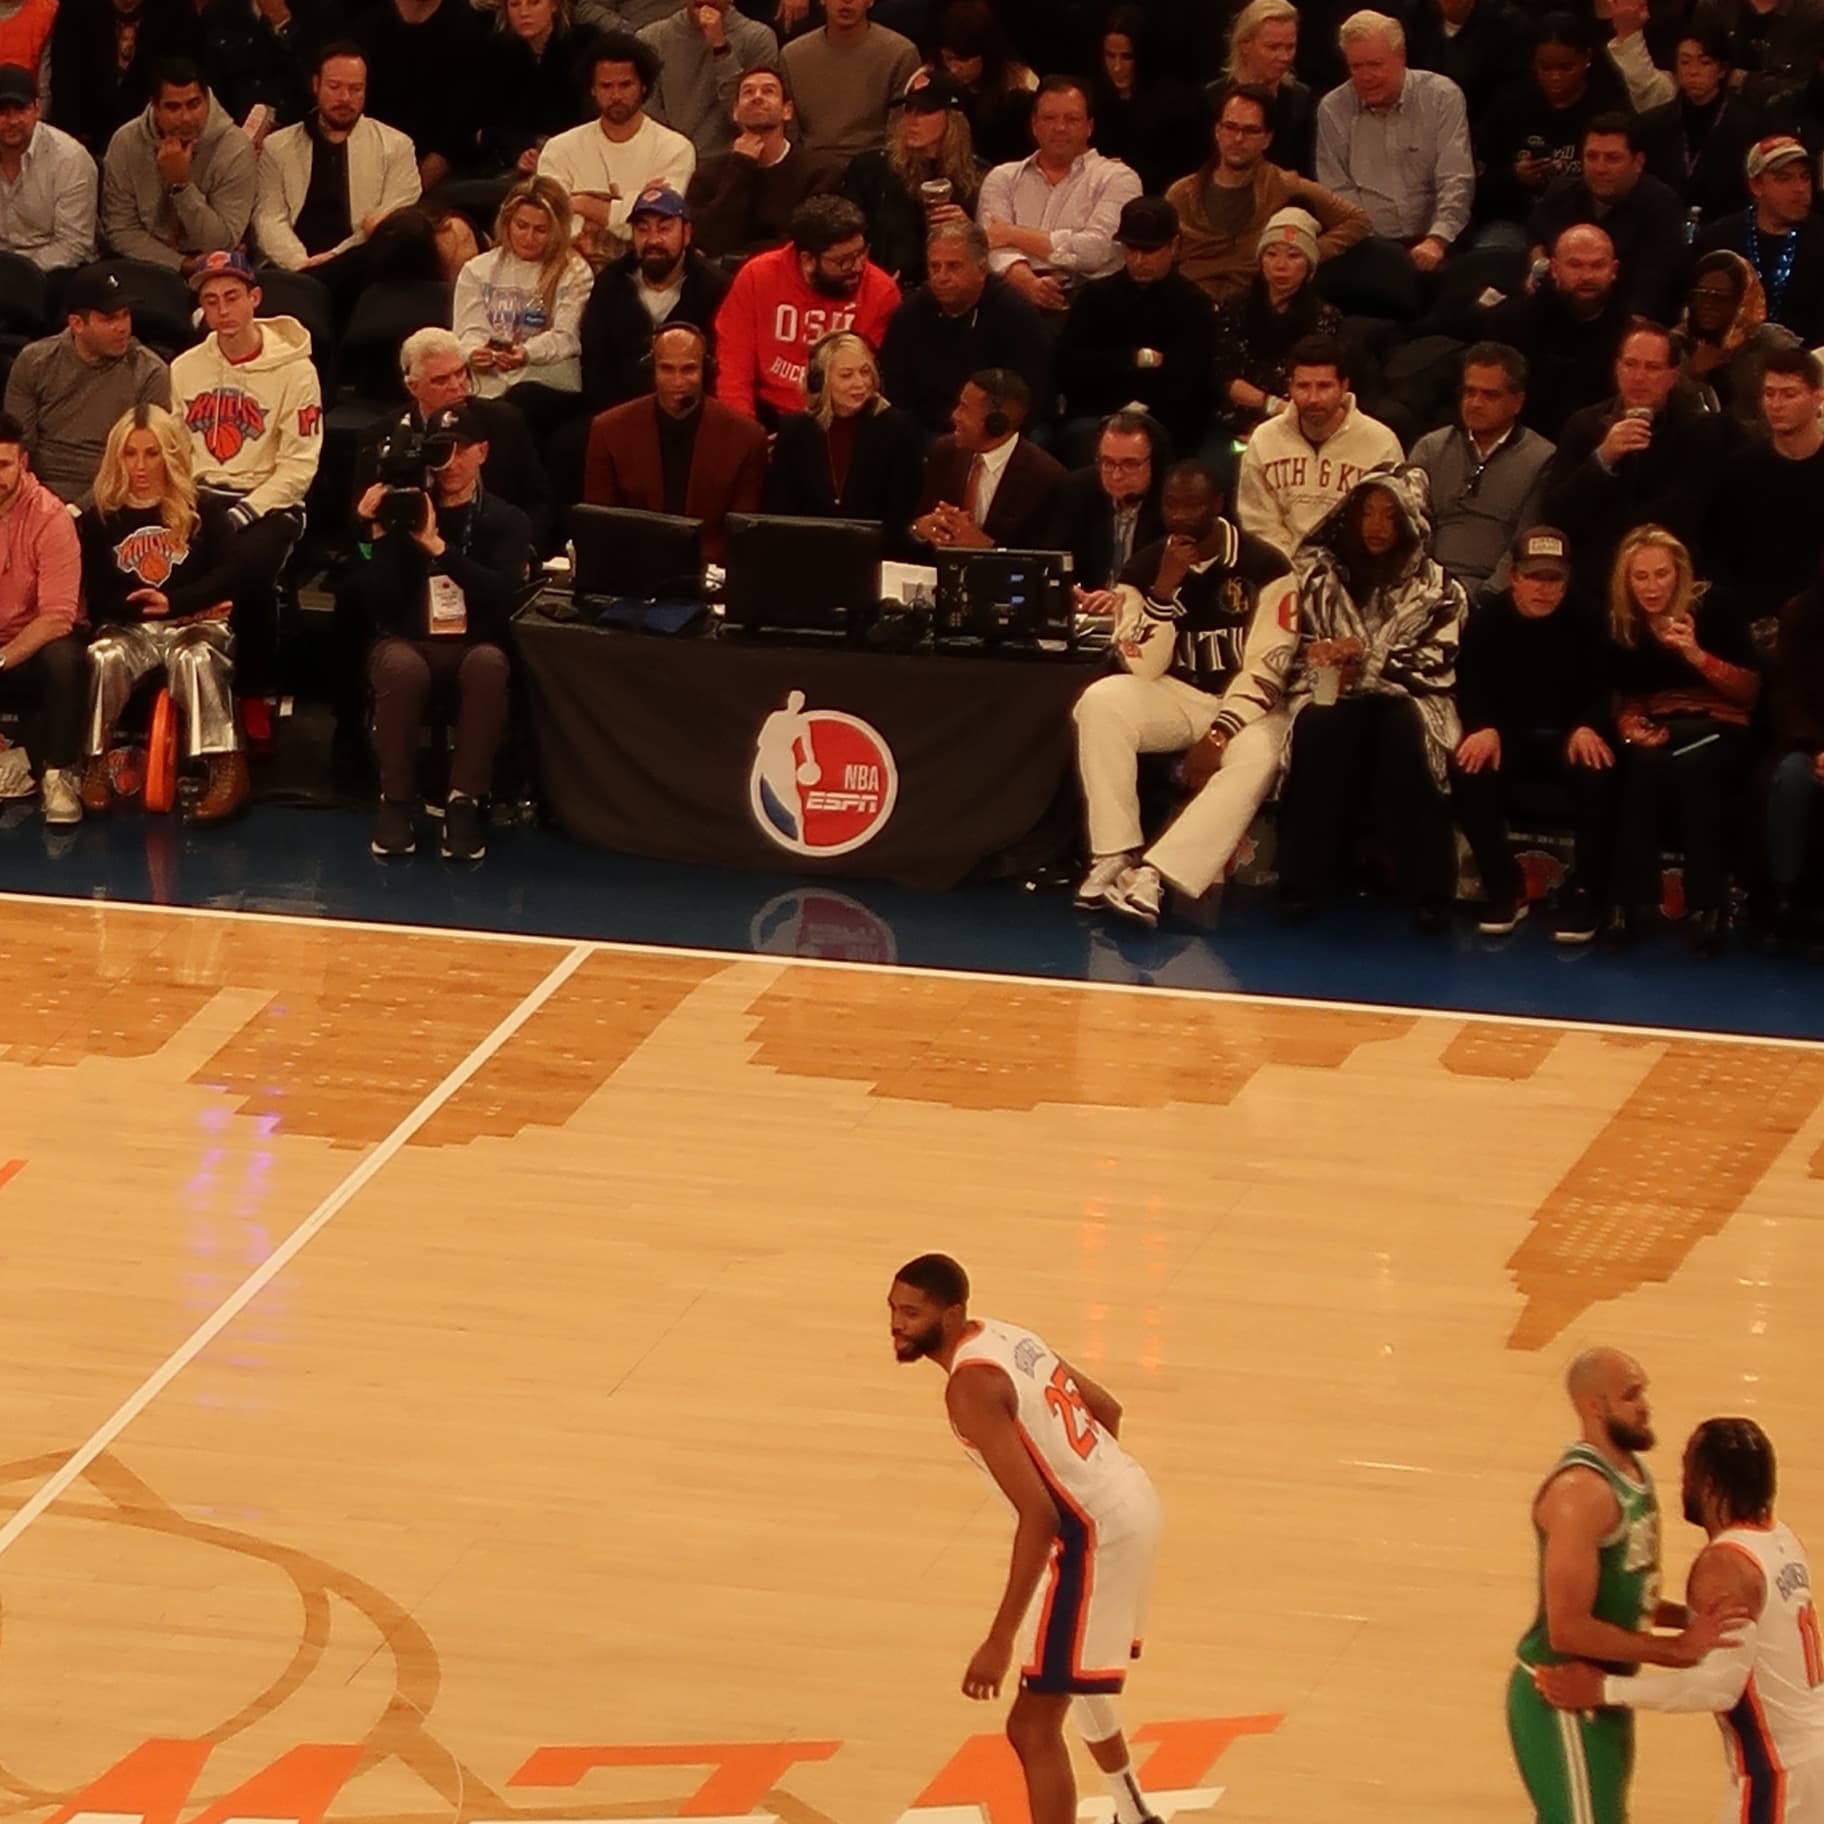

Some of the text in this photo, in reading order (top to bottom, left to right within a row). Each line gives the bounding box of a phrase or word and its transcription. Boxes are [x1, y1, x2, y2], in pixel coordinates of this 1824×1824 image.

[775, 303, 858, 346] OSU
[843, 763, 880, 793] NBA
[805, 789, 880, 814] ESPN
